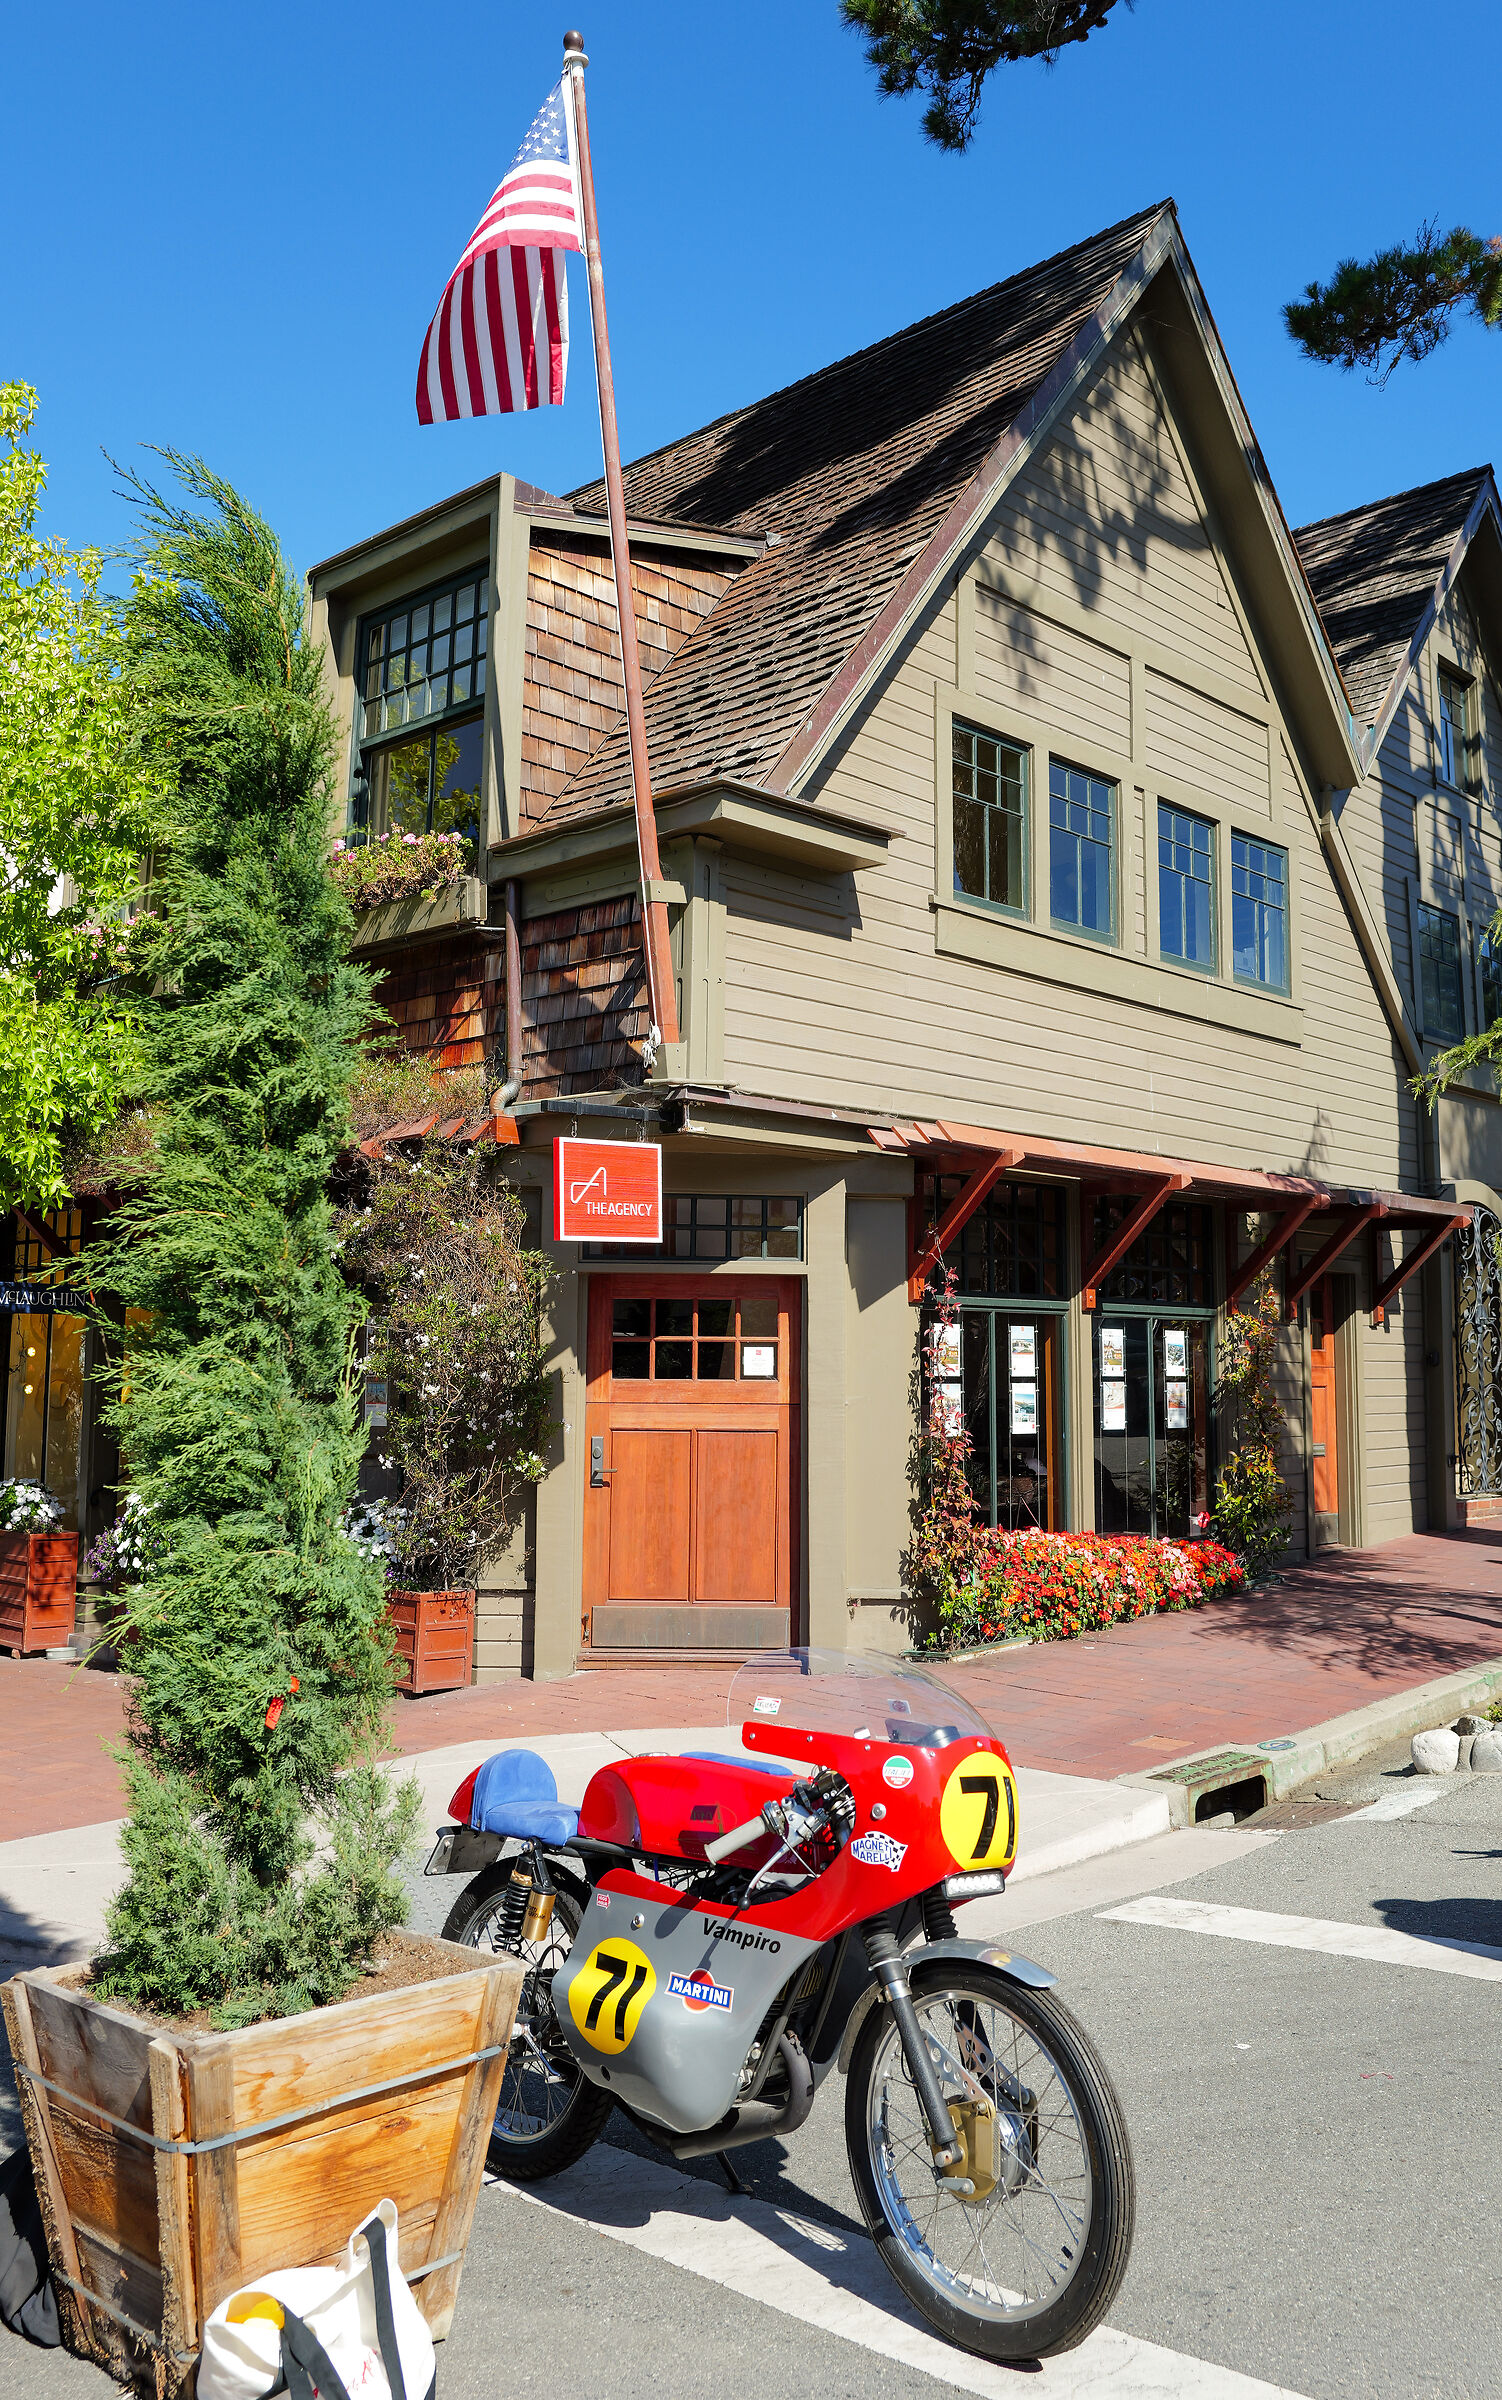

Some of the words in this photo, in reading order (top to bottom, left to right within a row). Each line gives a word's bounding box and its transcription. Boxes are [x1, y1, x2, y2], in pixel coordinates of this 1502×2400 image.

[959, 1775, 1015, 1859] 71
[703, 1917, 781, 1954] Vampiro
[584, 1951, 648, 2042] 71
[671, 1977, 729, 2006] MARTINI
